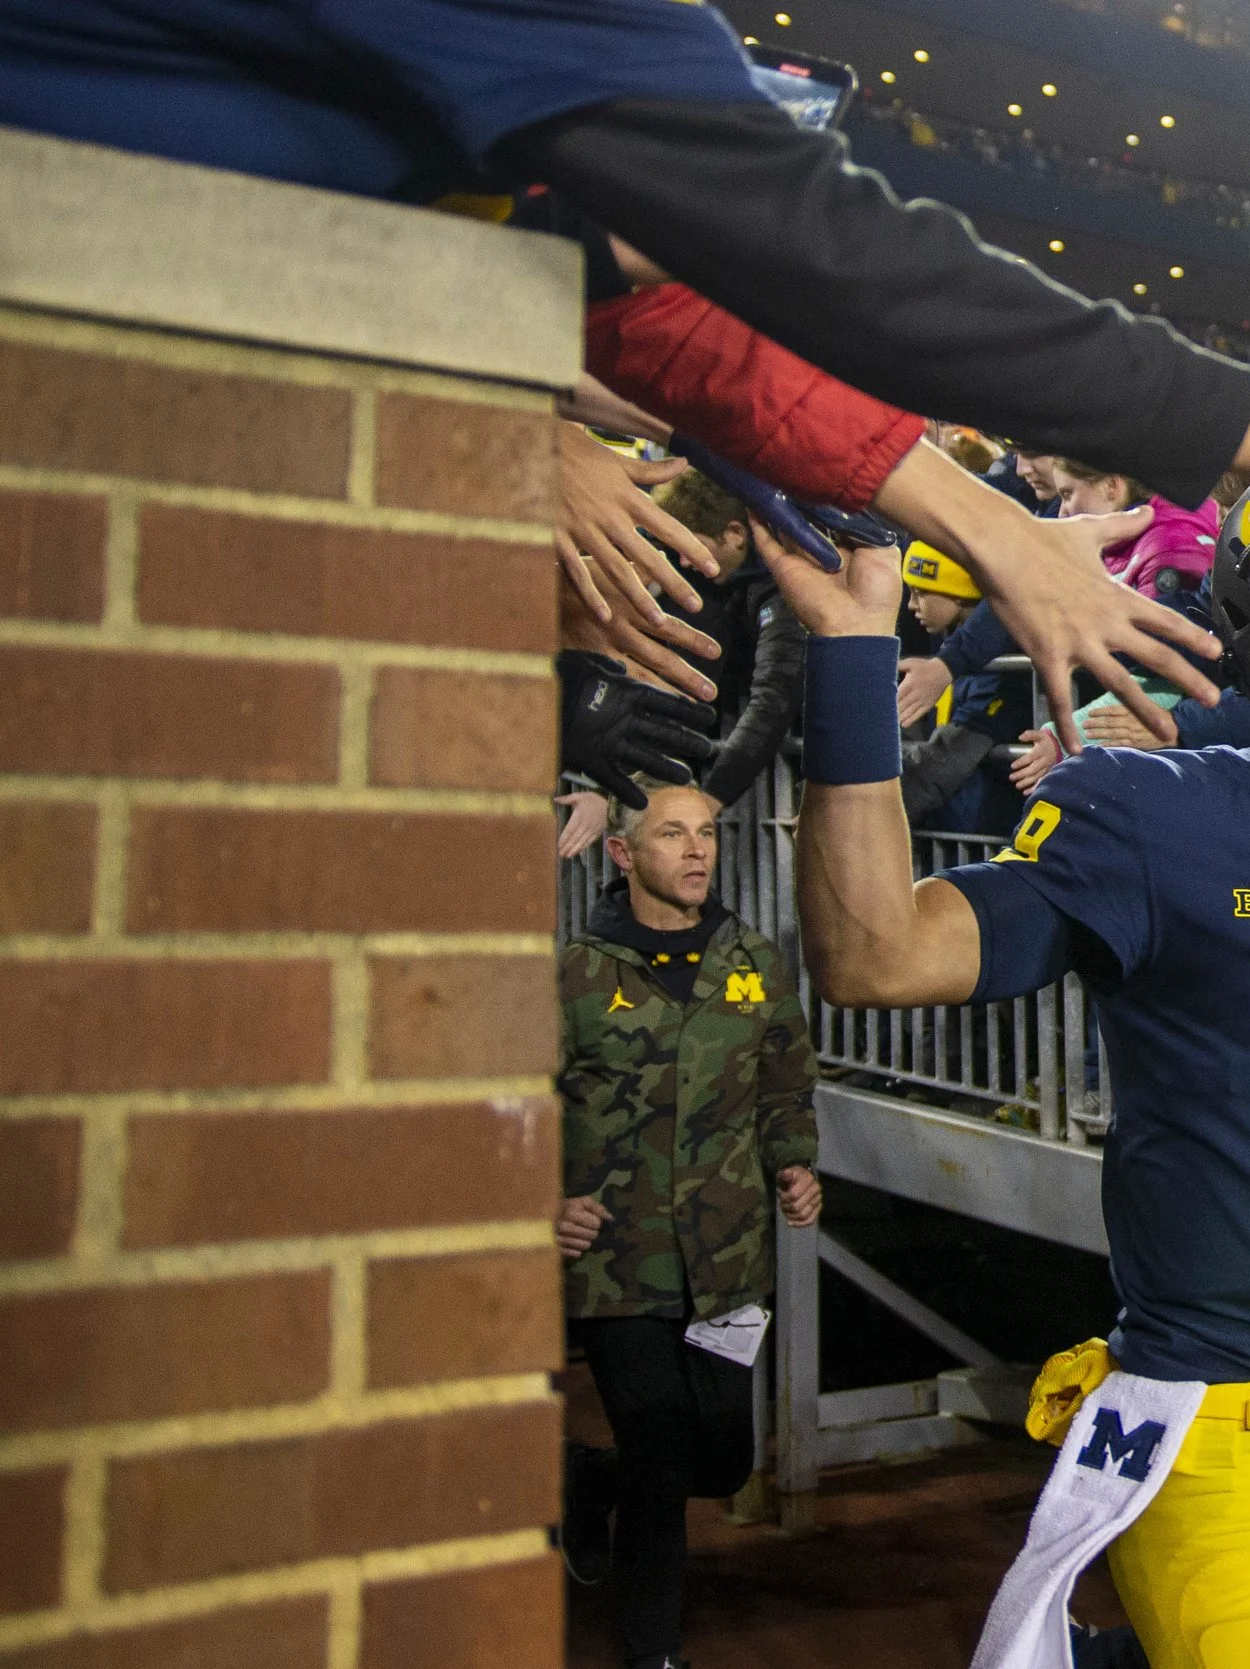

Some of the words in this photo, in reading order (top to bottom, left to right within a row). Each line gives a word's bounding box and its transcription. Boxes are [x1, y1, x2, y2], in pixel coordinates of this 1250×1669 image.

[988, 799, 1062, 863] 9
[725, 971, 766, 1003] M
[1075, 1406, 1167, 1483] M
